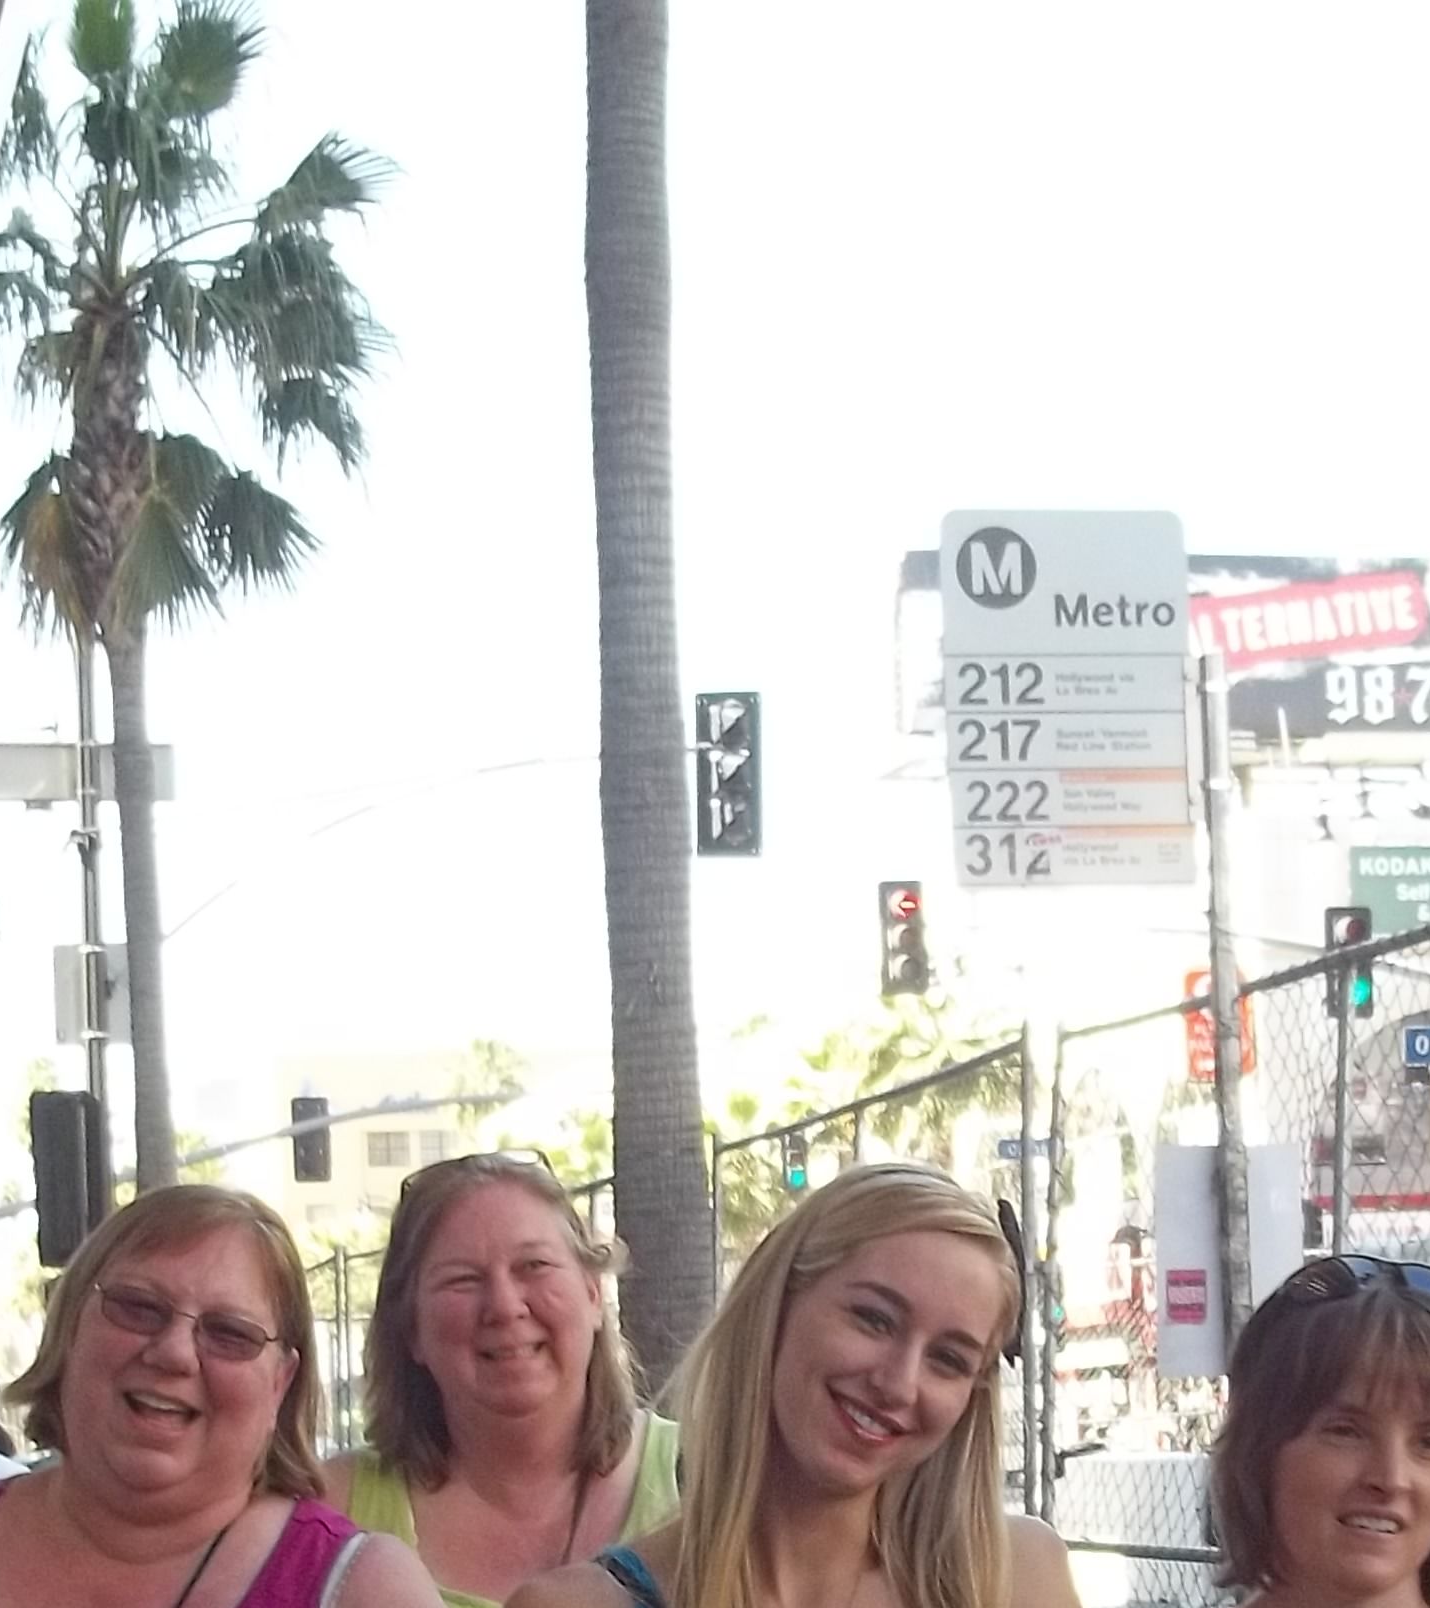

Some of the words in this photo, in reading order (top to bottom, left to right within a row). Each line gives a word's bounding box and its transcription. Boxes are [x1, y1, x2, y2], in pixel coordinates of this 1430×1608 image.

[1054, 593, 1175, 627] Metro
[957, 662, 1046, 706] 212
[957, 719, 1041, 761] 217
[966, 780, 1050, 822] 222
